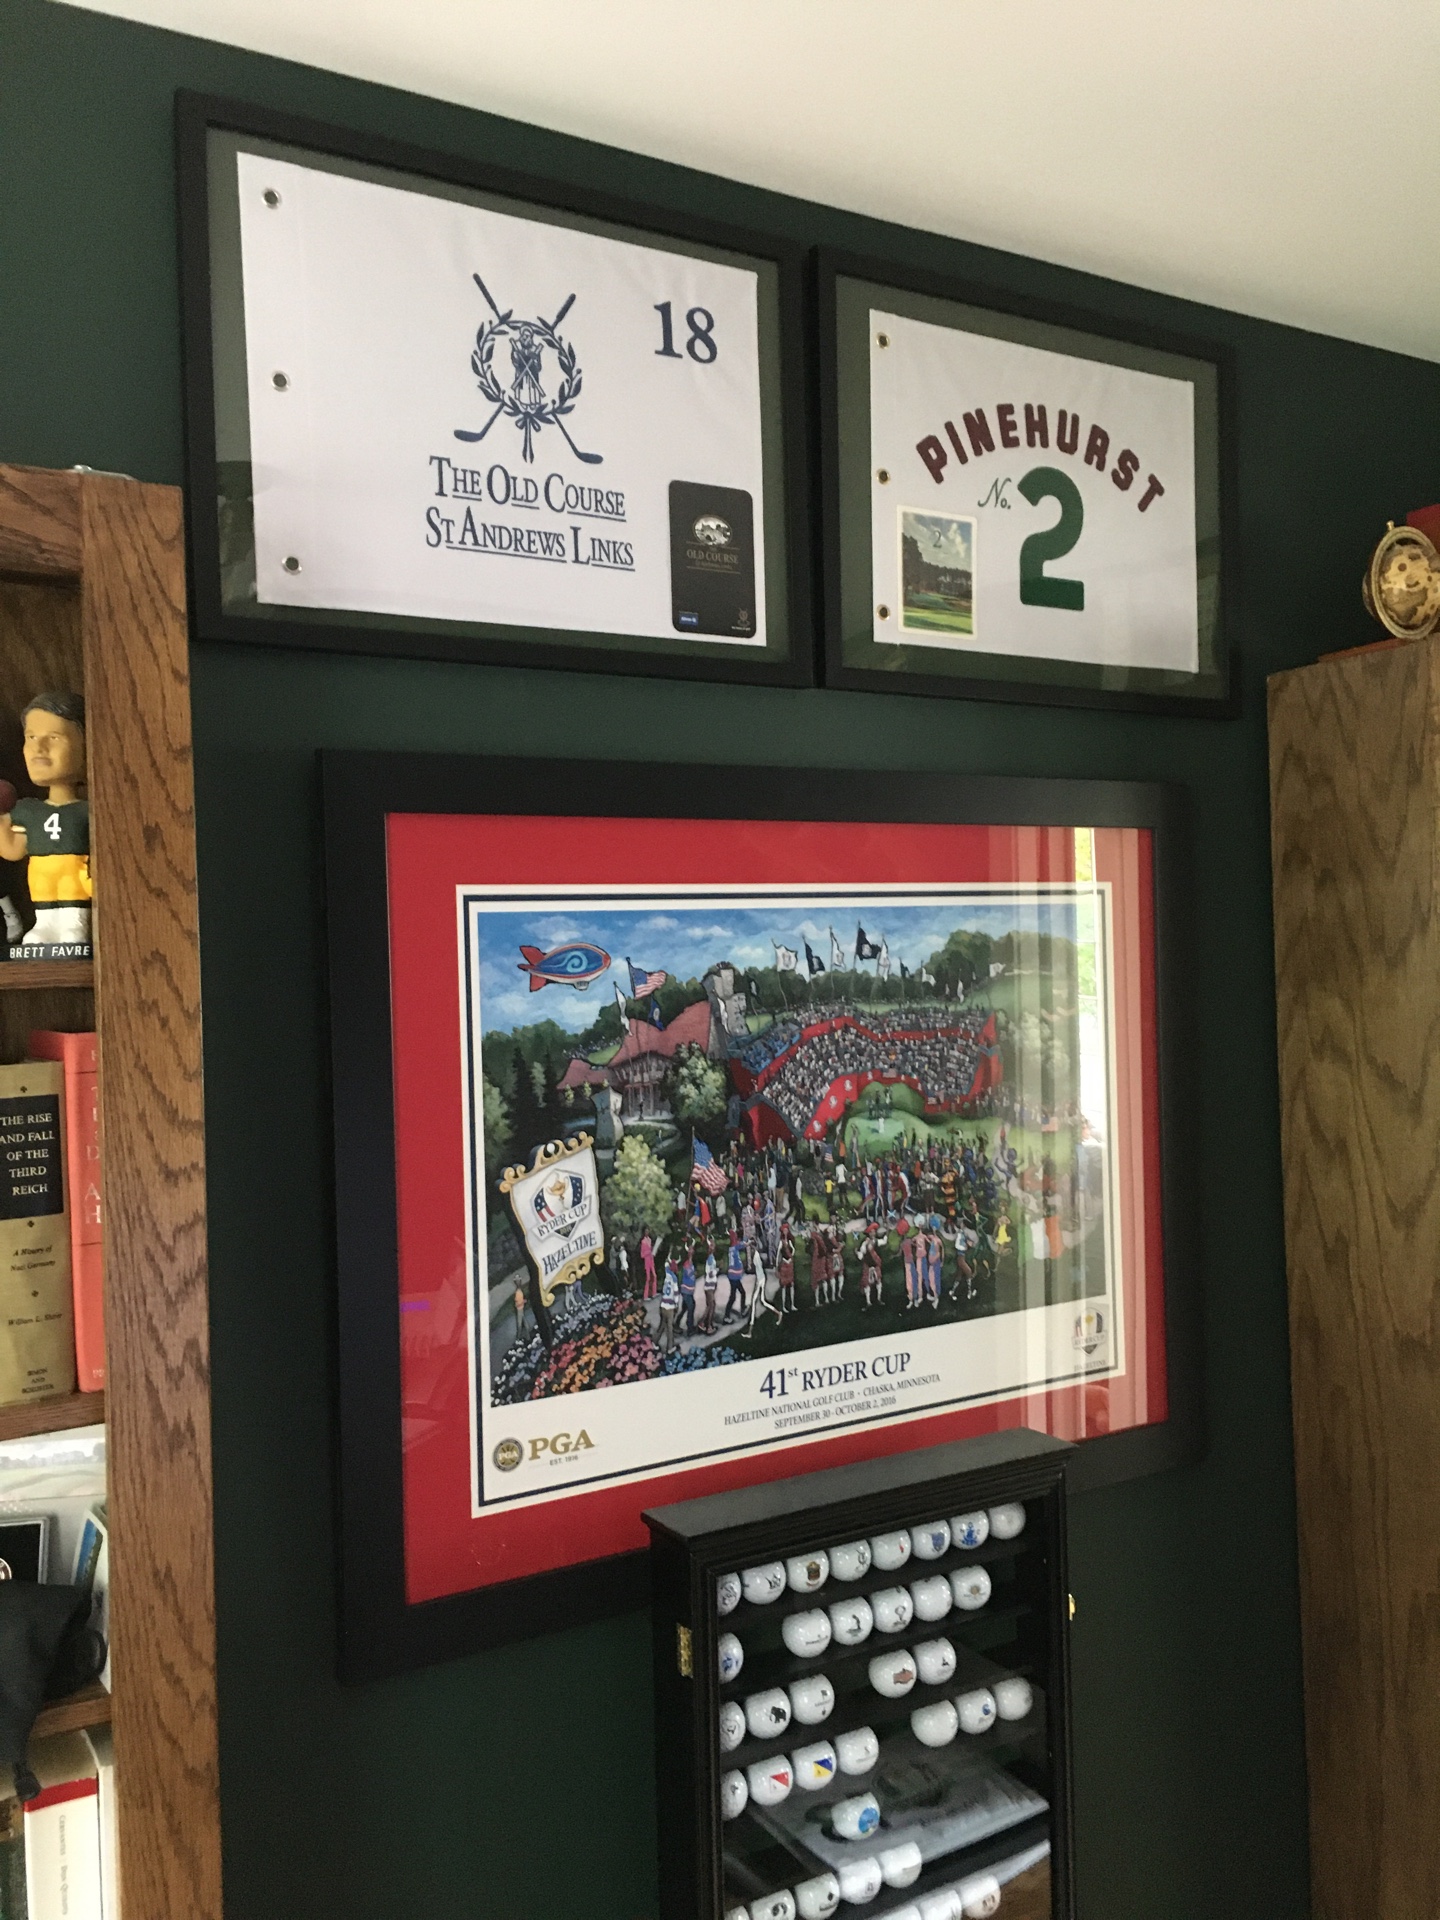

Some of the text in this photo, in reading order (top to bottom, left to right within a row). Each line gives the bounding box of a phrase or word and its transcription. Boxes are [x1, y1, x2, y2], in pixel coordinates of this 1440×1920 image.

[653, 301, 718, 364] 18
[916, 403, 1165, 513] PINEHURST
[1017, 466, 1085, 612] 2
[43, 813, 62, 840] 4
[9, 945, 90, 959] BRETT FAVRE
[0, 1112, 52, 1126] THE RISE
[0, 1130, 55, 1144] AND FALL
[6, 1148, 49, 1162] OF THE
[9, 1165, 47, 1178] THIRD
[12, 1183, 48, 1196] REICH
[537, 1203, 587, 1237] RYDER CUP
[542, 1230, 598, 1276] HAZELTINE
[802, 1360, 868, 1392] RYDER
[871, 1352, 911, 1378] CUP
[724, 1407, 770, 1426] HAZELTINE
[771, 1399, 811, 1416] NATIONAL
[812, 1393, 834, 1408] GOLF
[834, 1390, 855, 1404] CLUB
[896, 1373, 941, 1390] MINNESOTA
[774, 1410, 821, 1430] SEPTEMBER
[822, 1408, 831, 1419] 30
[835, 1399, 872, 1416] OCTOBER
[528, 1429, 595, 1461] PGA
